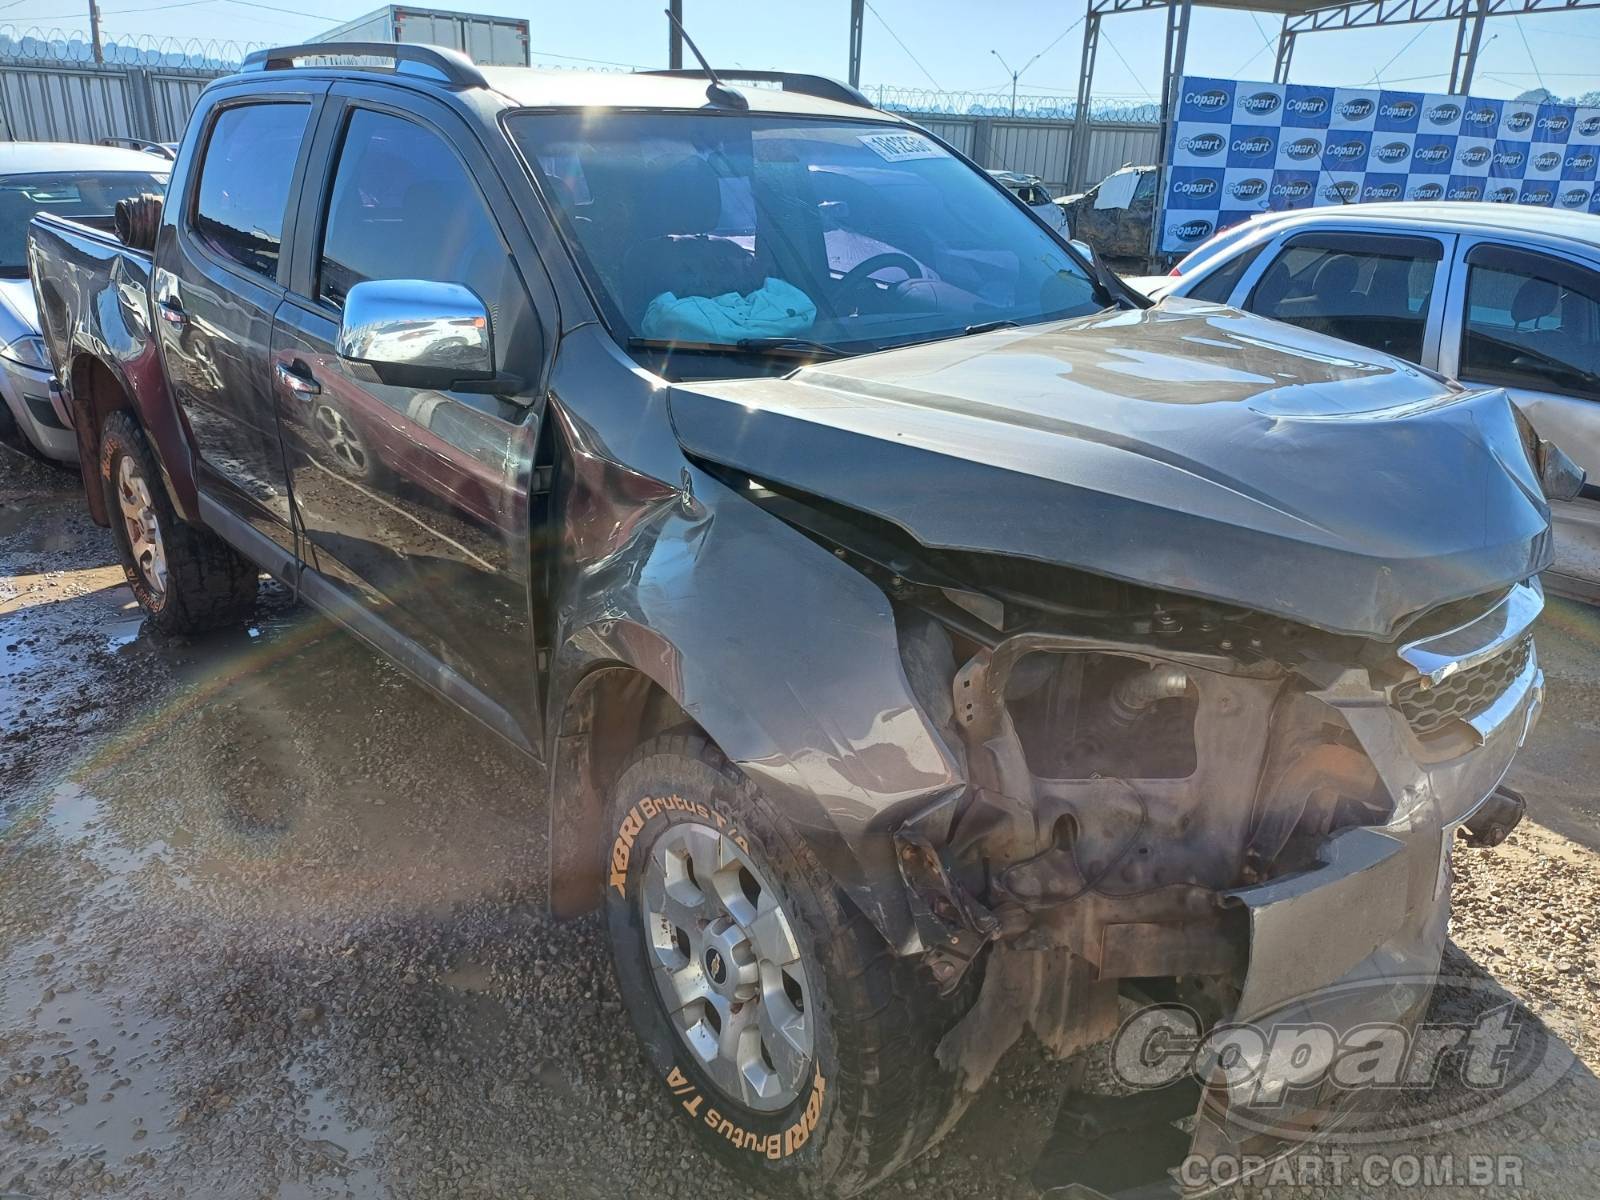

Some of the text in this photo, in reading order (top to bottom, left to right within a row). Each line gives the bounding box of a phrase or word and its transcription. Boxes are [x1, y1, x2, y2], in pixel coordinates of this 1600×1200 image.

[1185, 92, 1225, 109] Copart
[1238, 95, 1276, 110] Copart
[1286, 99, 1324, 113] Copart
[1335, 102, 1370, 117] Copart
[1380, 104, 1414, 119] Copart
[1424, 107, 1456, 120] Copart
[1464, 110, 1495, 124] Copart
[1537, 117, 1567, 131] Copart
[1179, 138, 1220, 152] Copart
[1231, 140, 1270, 154] Copart
[1326, 144, 1362, 157] Copart
[1372, 147, 1405, 159] Copart
[1415, 149, 1447, 161] Copart
[1457, 149, 1486, 161] Copart
[1494, 153, 1521, 165] Copart
[1173, 181, 1214, 195] Copart
[1225, 183, 1261, 196] Copart
[1272, 184, 1308, 196] Copart
[1364, 186, 1397, 199] Copart
[1408, 187, 1438, 199] Copart
[1448, 189, 1478, 200] Copart
[1167, 224, 1207, 238] Copart
[610, 806, 646, 898] XBRI
[639, 794, 709, 820] Brutus
[666, 1056, 826, 1159] XBRI Brutus T/A
